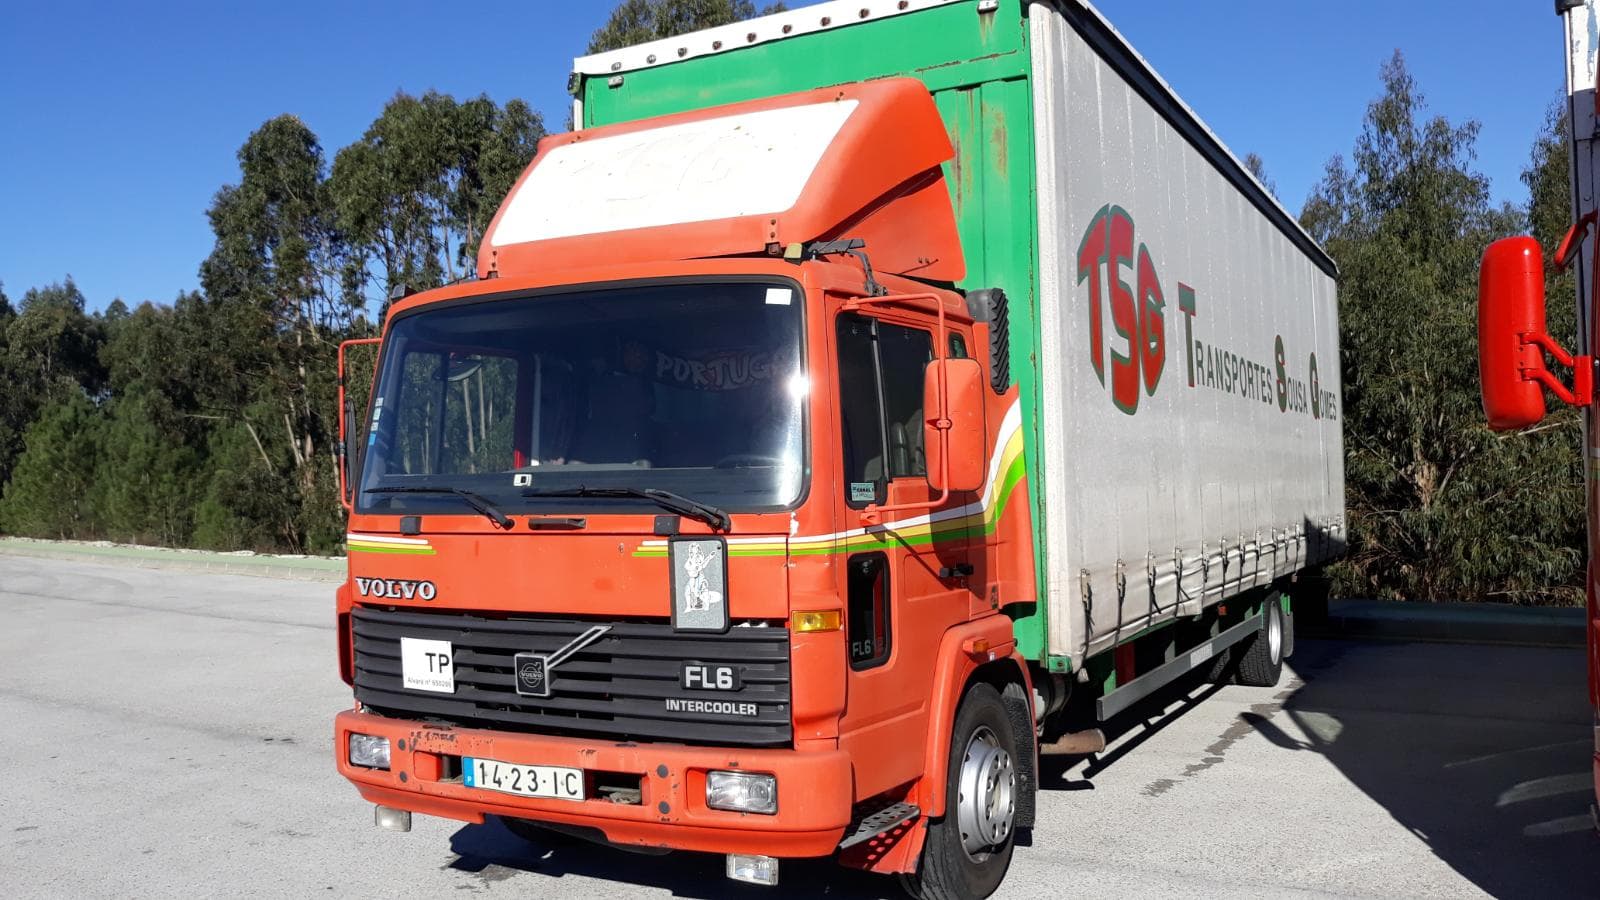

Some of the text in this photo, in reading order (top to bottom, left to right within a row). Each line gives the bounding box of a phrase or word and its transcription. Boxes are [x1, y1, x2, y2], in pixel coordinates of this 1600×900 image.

[1076, 202, 1166, 415] TSG
[1178, 281, 1337, 421] TRANSPORTES SOUSA GOMES
[355, 576, 437, 600] VOLVO
[425, 652, 450, 674] TP
[520, 670, 544, 679] VOLVO
[685, 666, 733, 689] FL6
[665, 699, 757, 716] INTERCOOLER
